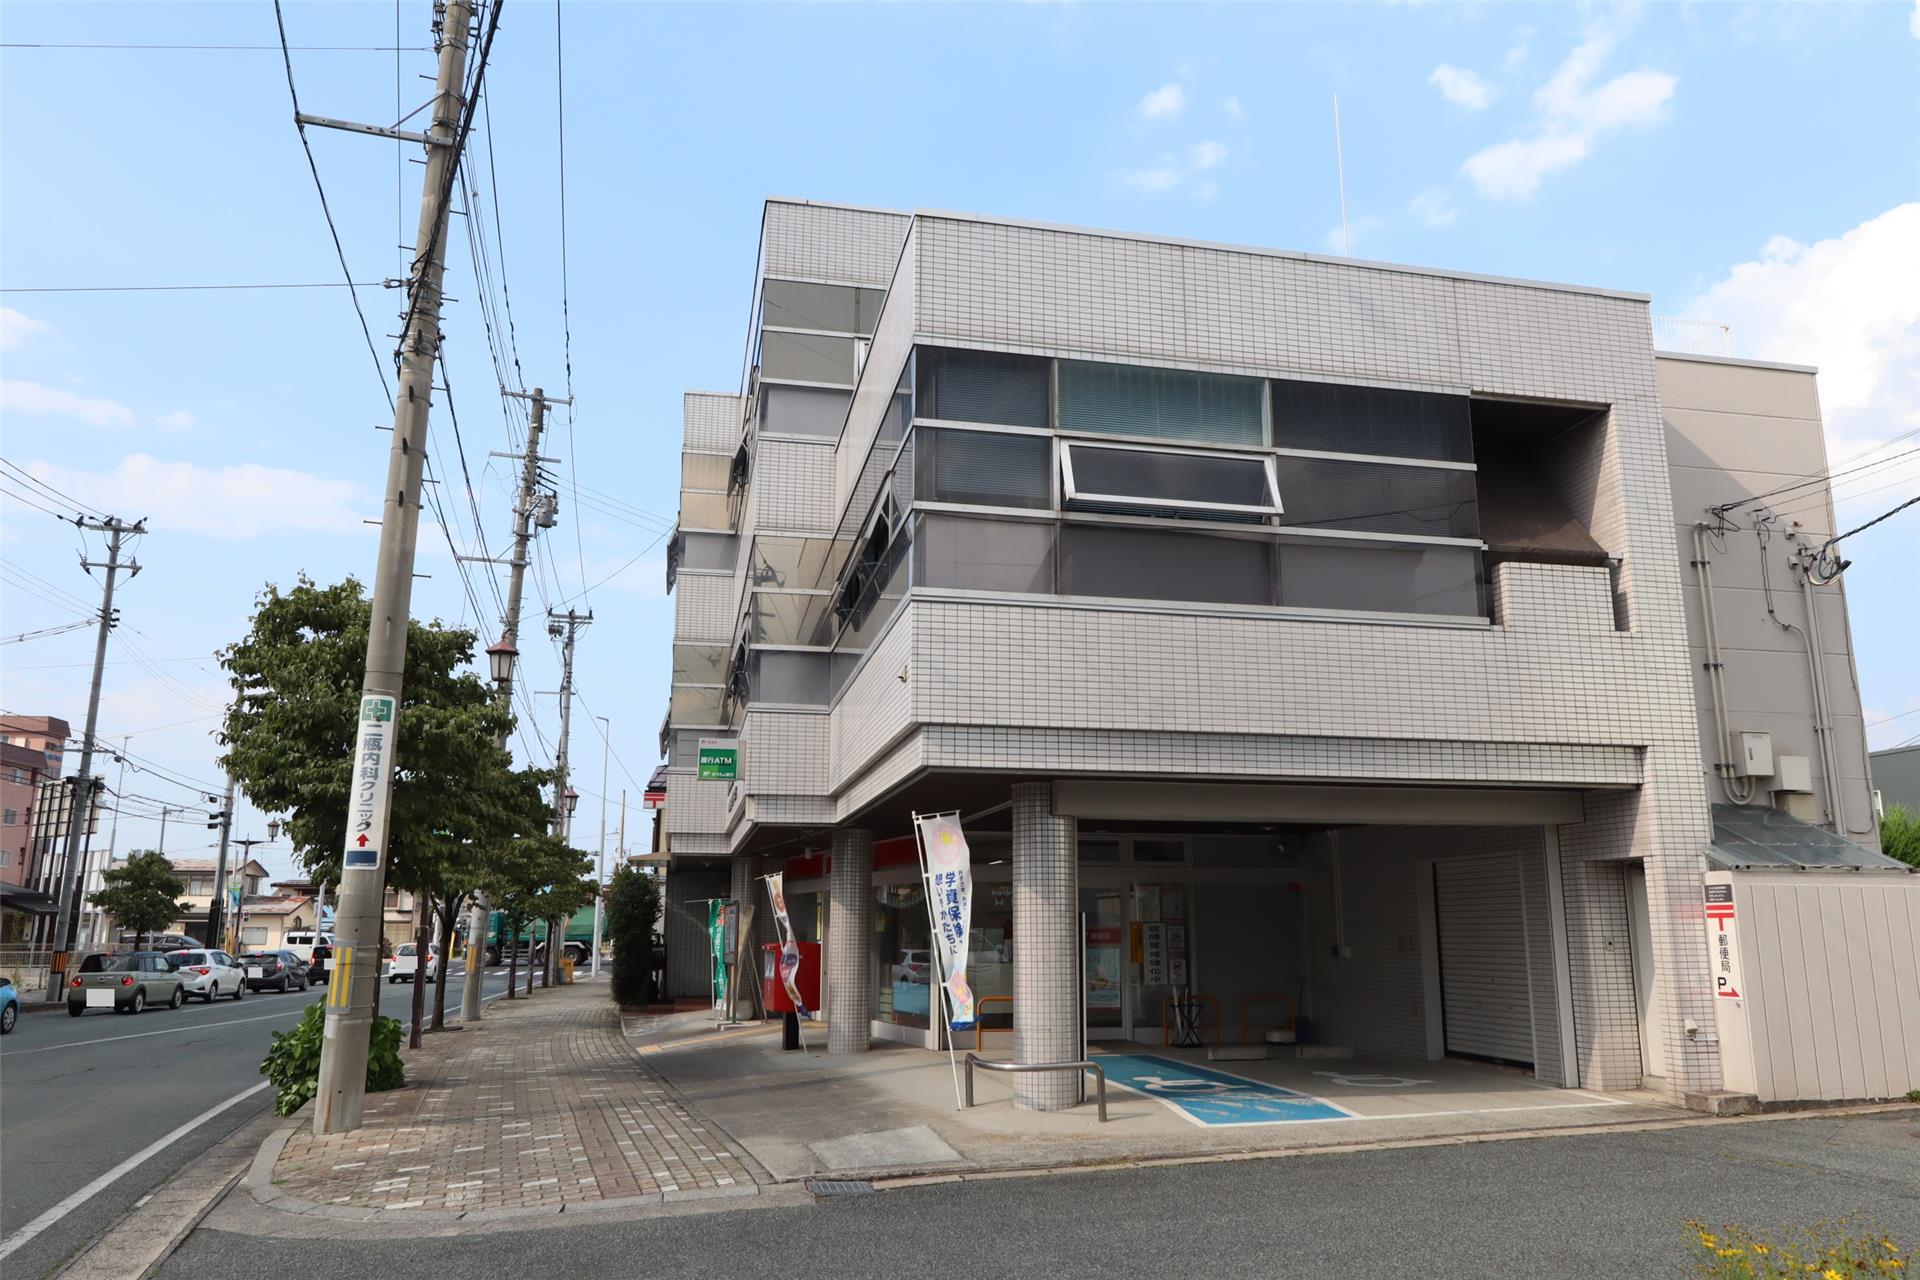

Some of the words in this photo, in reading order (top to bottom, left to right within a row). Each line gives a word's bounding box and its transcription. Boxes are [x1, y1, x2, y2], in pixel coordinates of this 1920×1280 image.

[356, 724, 383, 832] 二瓶内科クリニック
[1719, 934, 1731, 973] 郵便局
[1717, 977, 1727, 990] P
